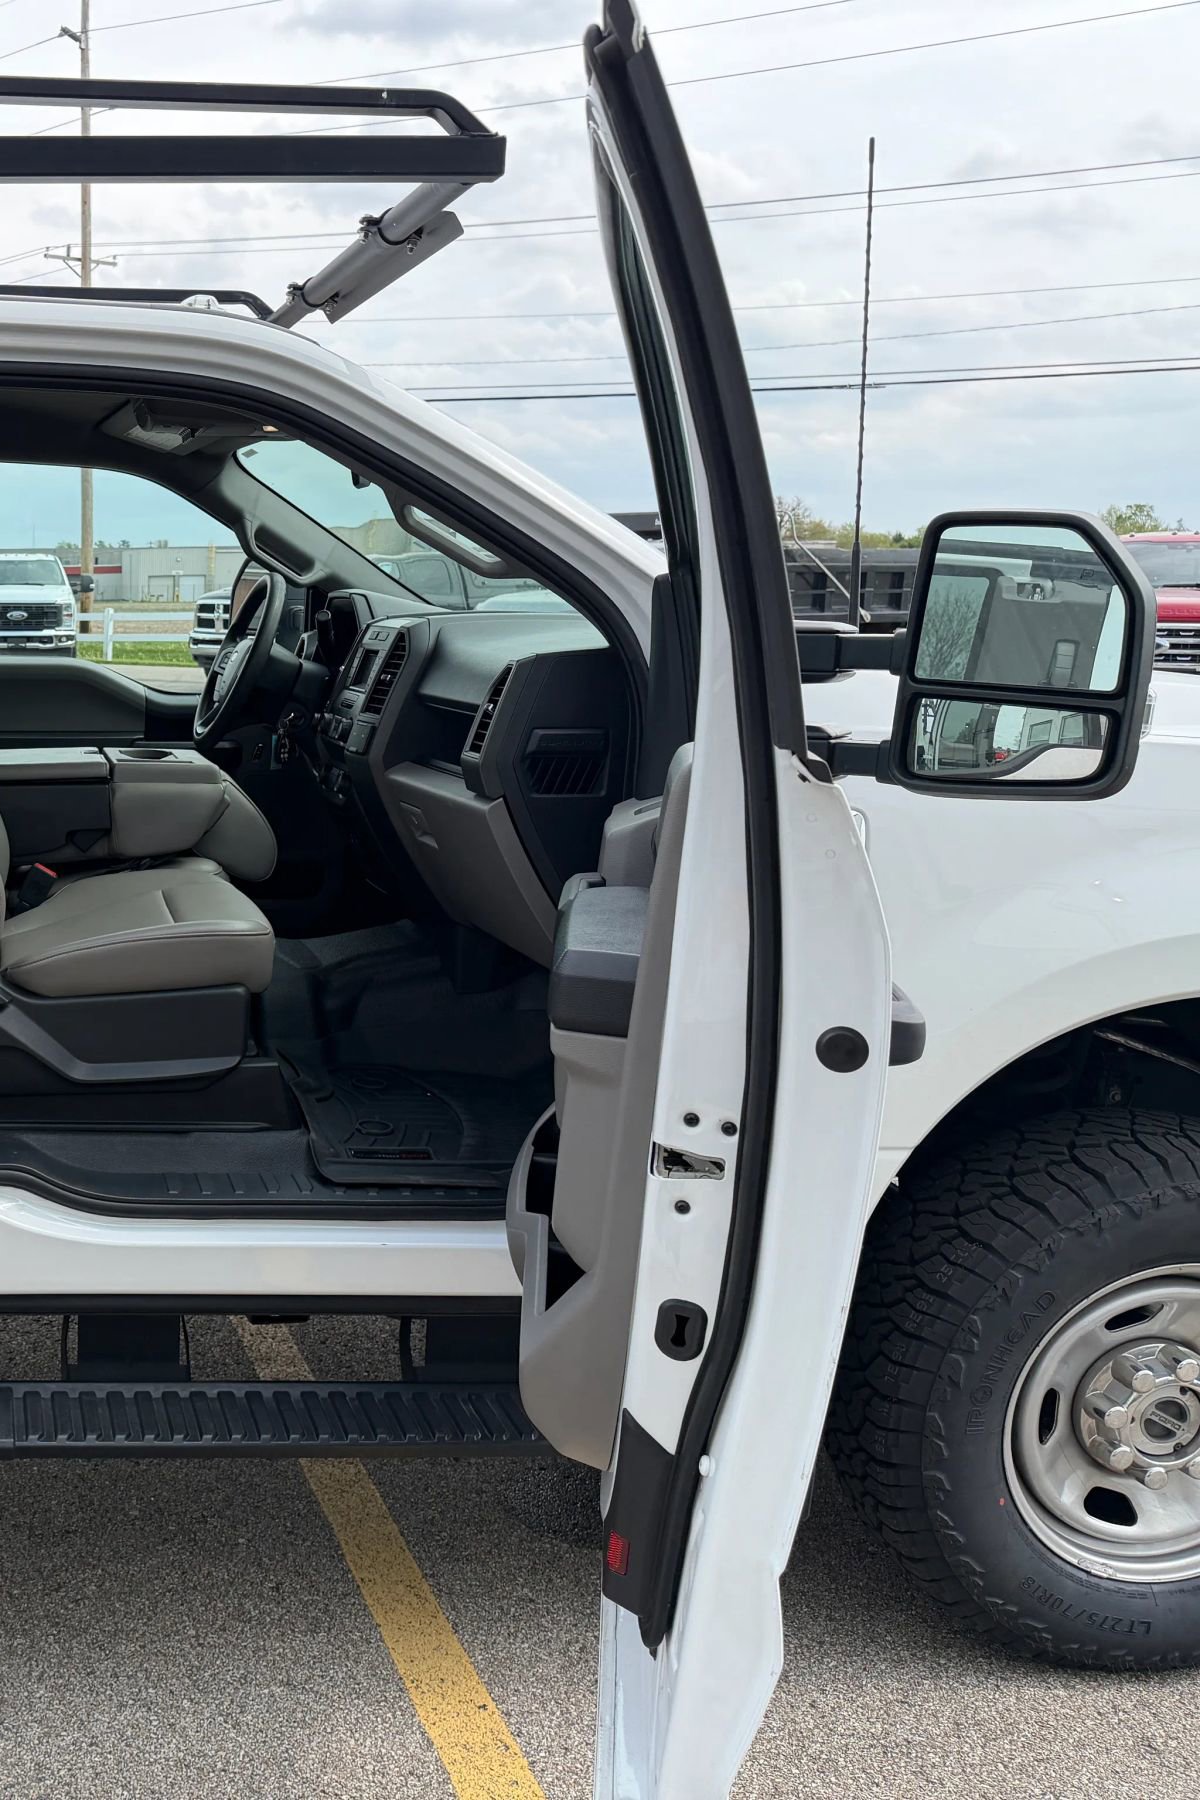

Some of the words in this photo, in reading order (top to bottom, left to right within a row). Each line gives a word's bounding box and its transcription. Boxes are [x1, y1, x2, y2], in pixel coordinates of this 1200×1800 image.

[966, 1290, 1056, 1434] IRONHEAD
[1150, 1410, 1182, 1431] FORD
[1018, 1576, 1152, 1638] LT275/70R18
